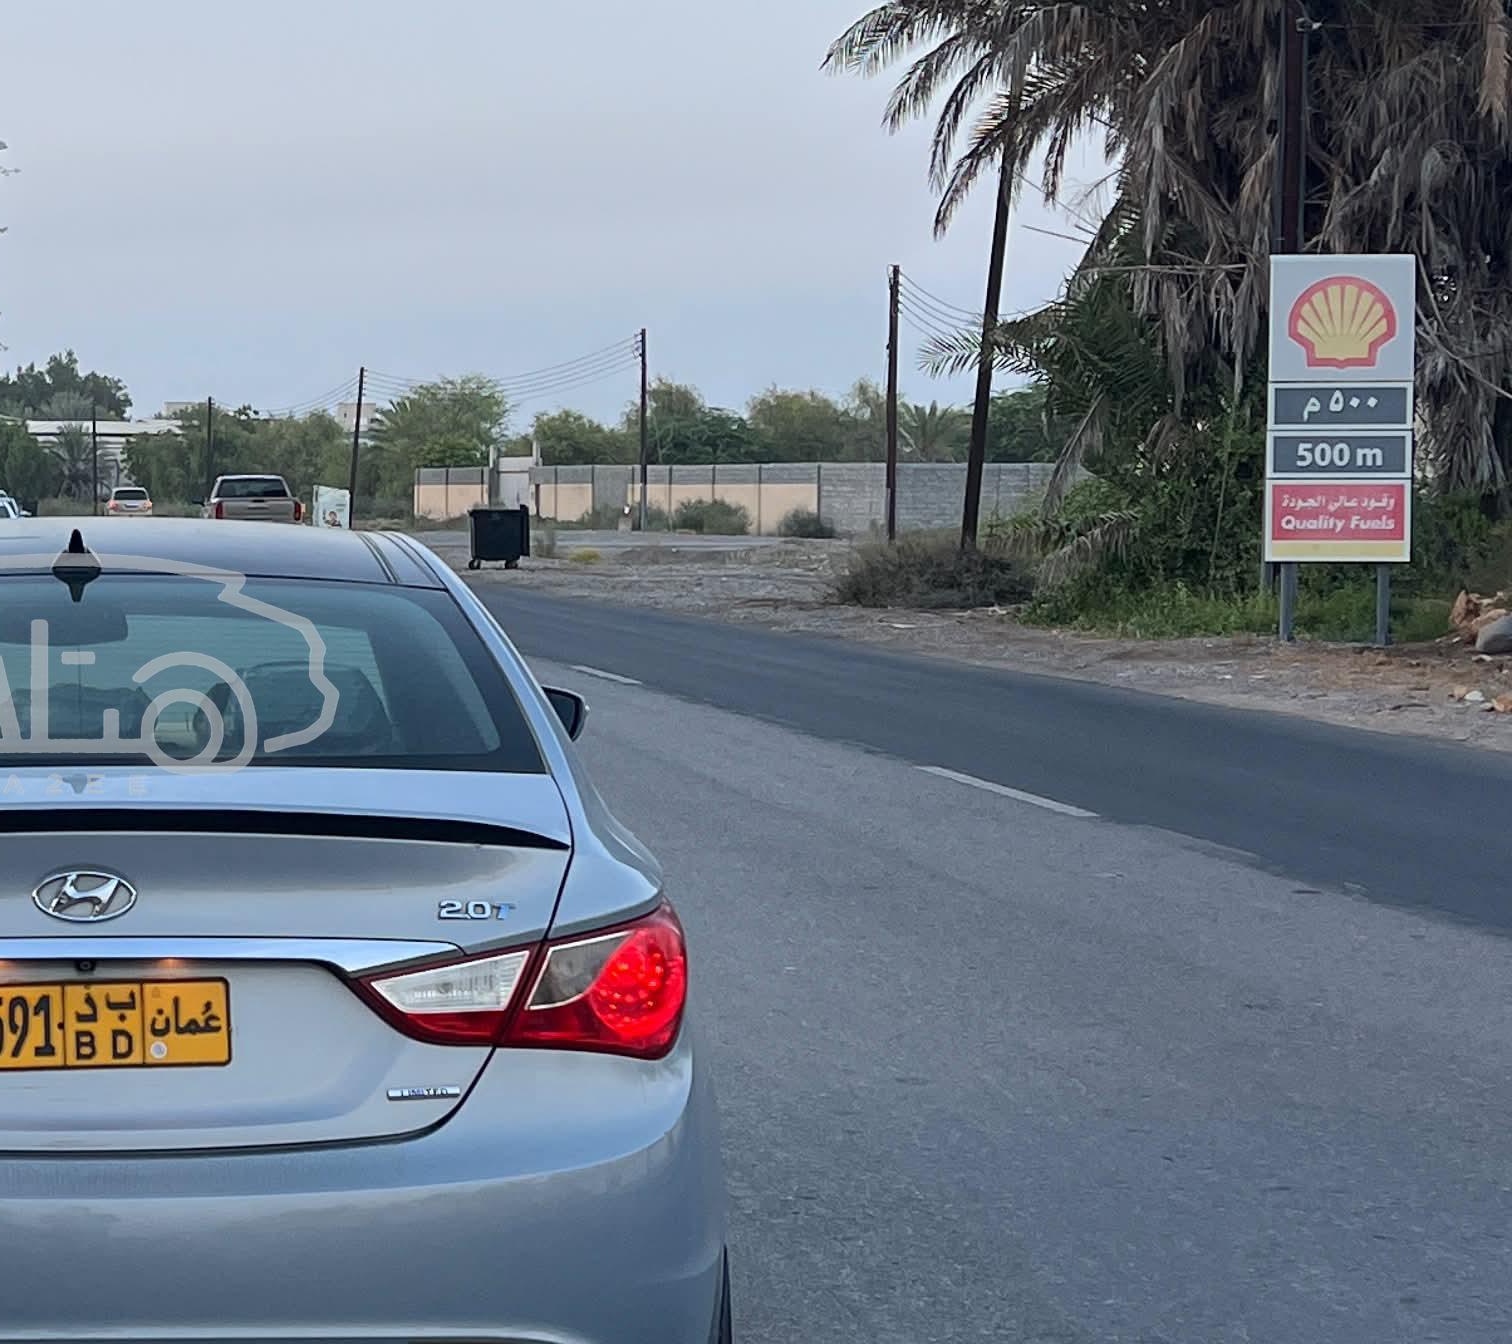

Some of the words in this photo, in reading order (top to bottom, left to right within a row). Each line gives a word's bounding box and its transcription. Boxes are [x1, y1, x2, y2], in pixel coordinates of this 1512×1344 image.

[1303, 397, 1321, 422] م
[1329, 389, 1378, 412] ٥٠٠
[1296, 442, 1350, 467] 500
[1356, 447, 1383, 467] m
[1281, 515, 1345, 533] Quality
[1350, 515, 1395, 530] Fuels
